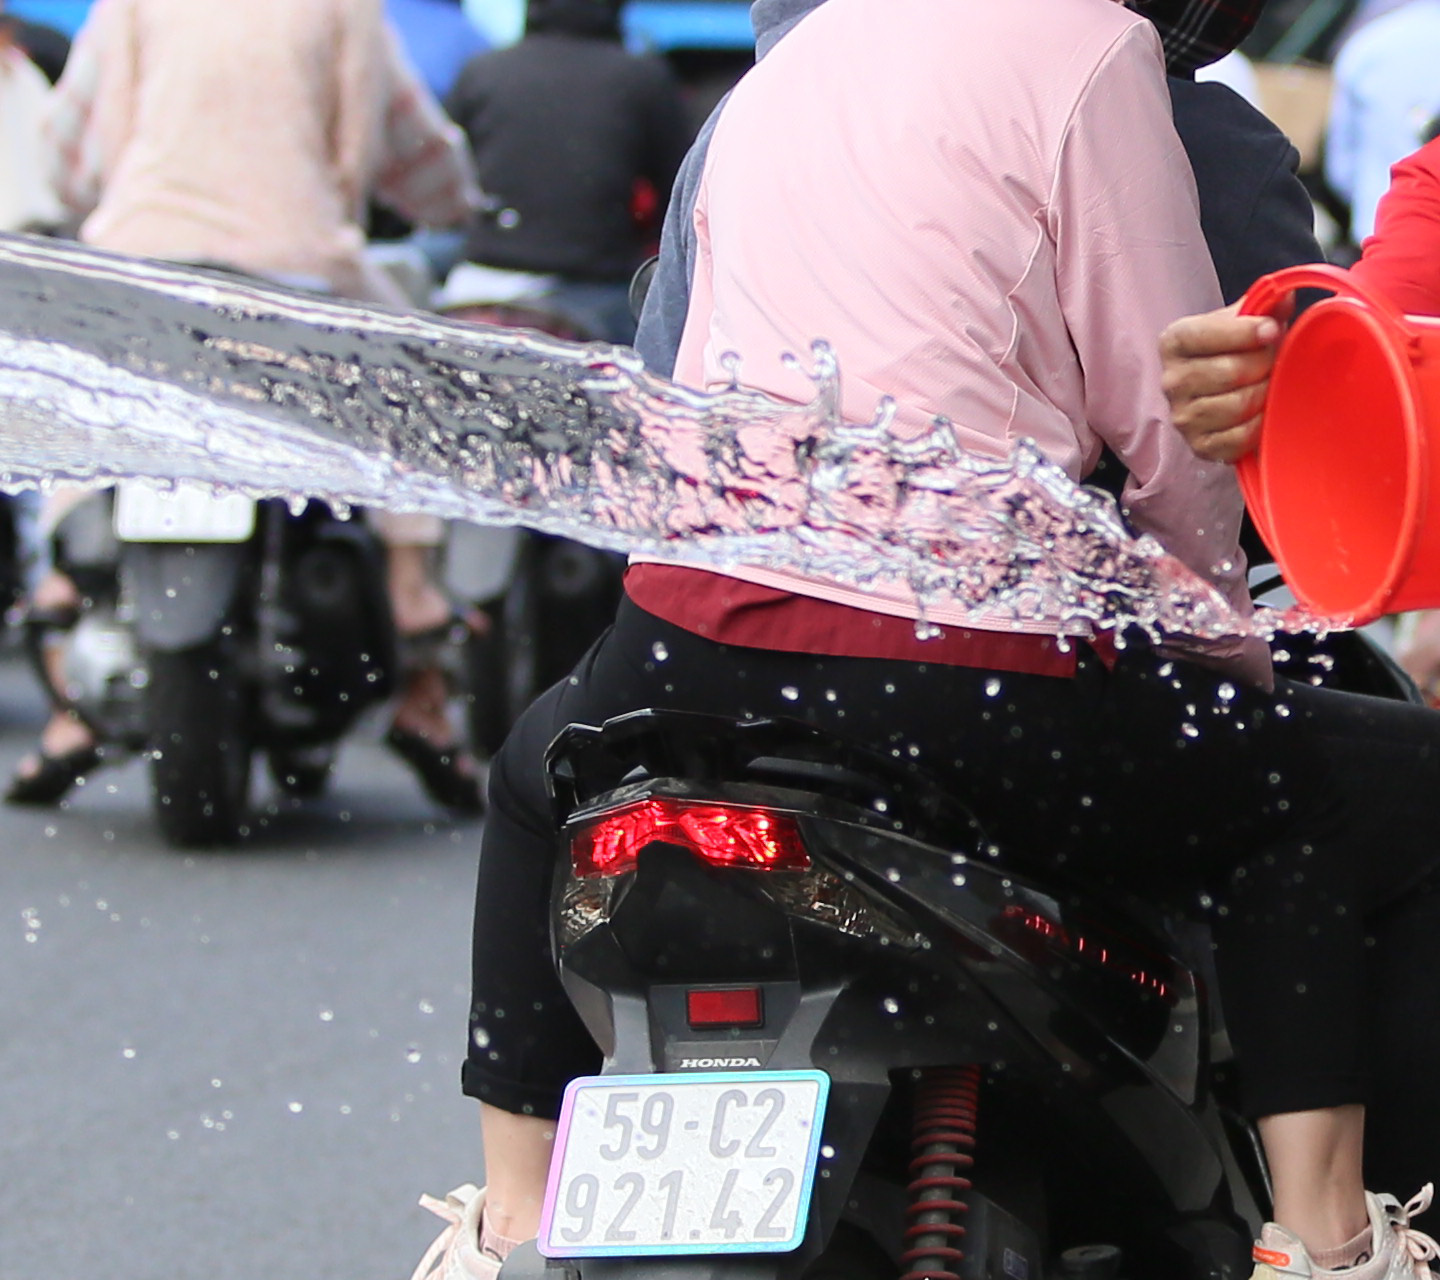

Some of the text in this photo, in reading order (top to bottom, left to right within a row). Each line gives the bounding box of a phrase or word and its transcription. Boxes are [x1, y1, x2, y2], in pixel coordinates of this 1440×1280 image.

[679, 1057, 761, 1069] HONDA
[598, 1088, 786, 1161] 59-C2
[560, 1166, 795, 1242] 921.42
